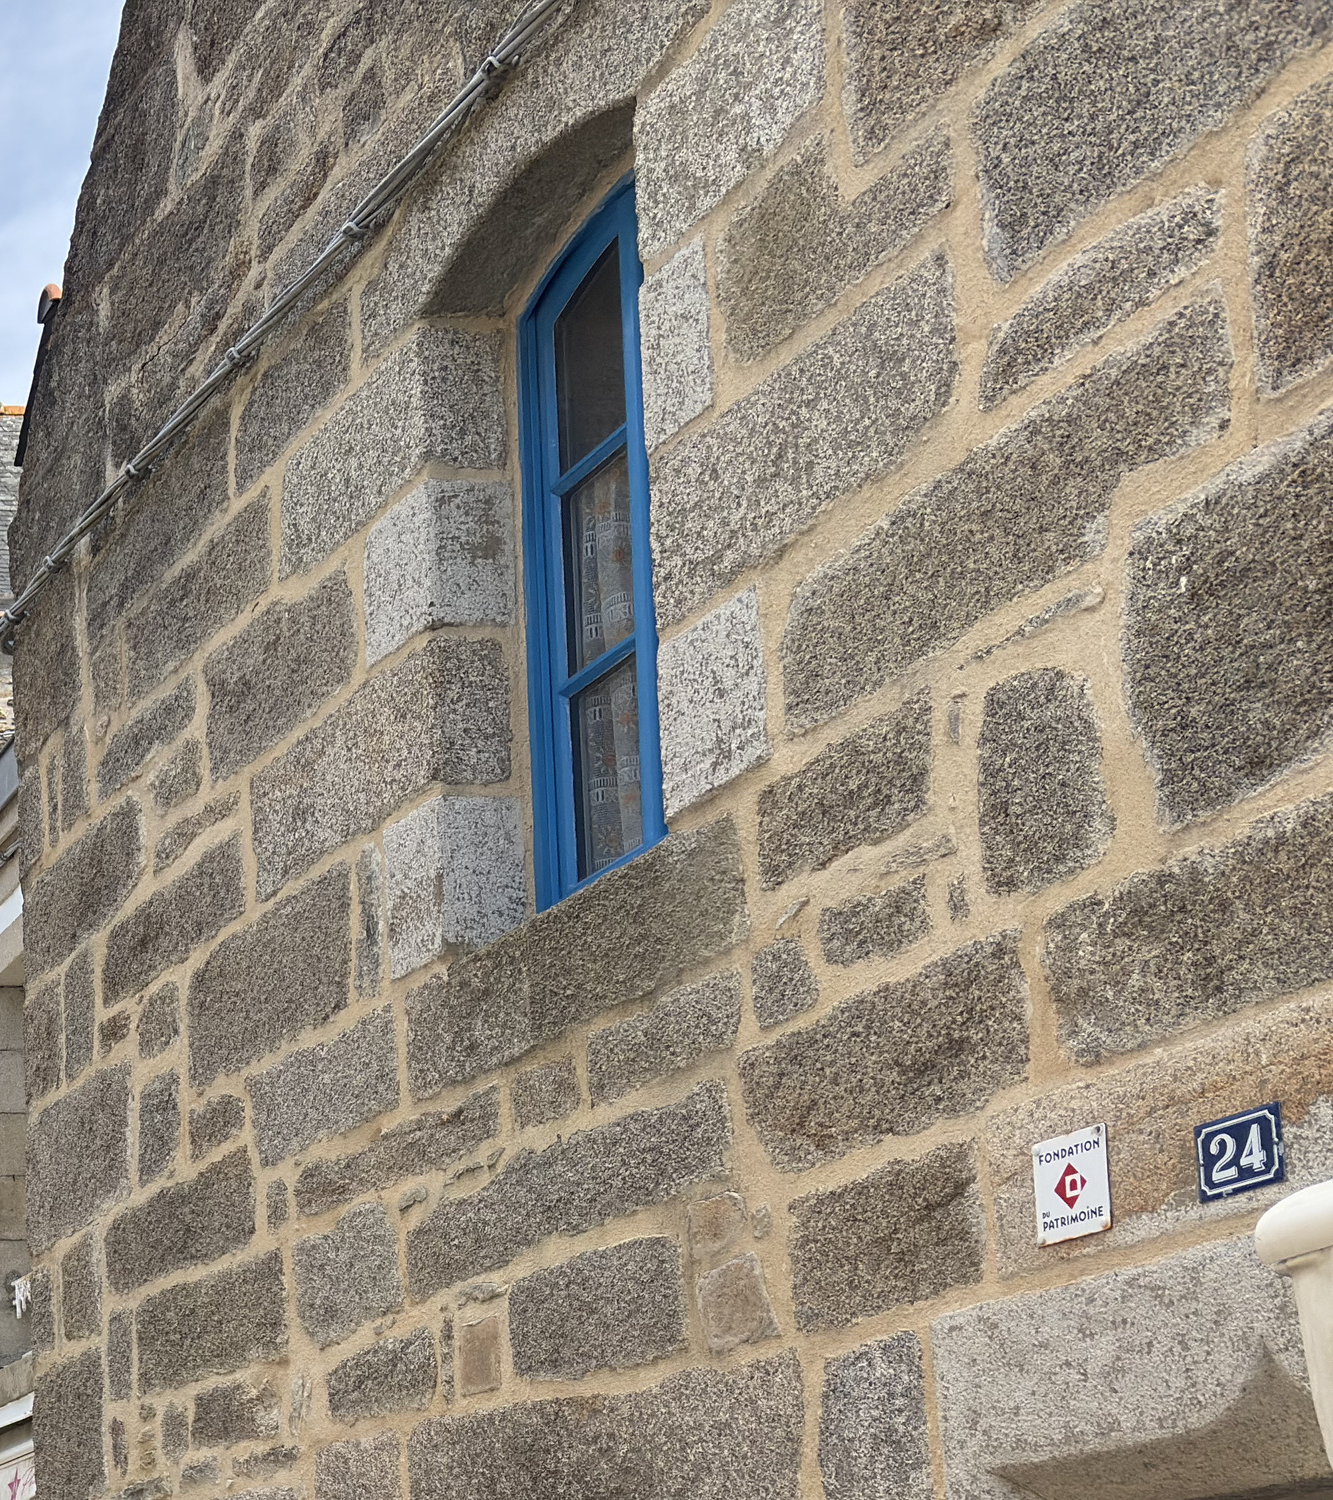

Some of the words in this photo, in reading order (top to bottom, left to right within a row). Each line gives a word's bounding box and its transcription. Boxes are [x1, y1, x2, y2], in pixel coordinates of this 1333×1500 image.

[1038, 1137, 1101, 1165] FONDATION
[1209, 1122, 1268, 1184] 24
[1042, 1211, 1051, 1219] DU
